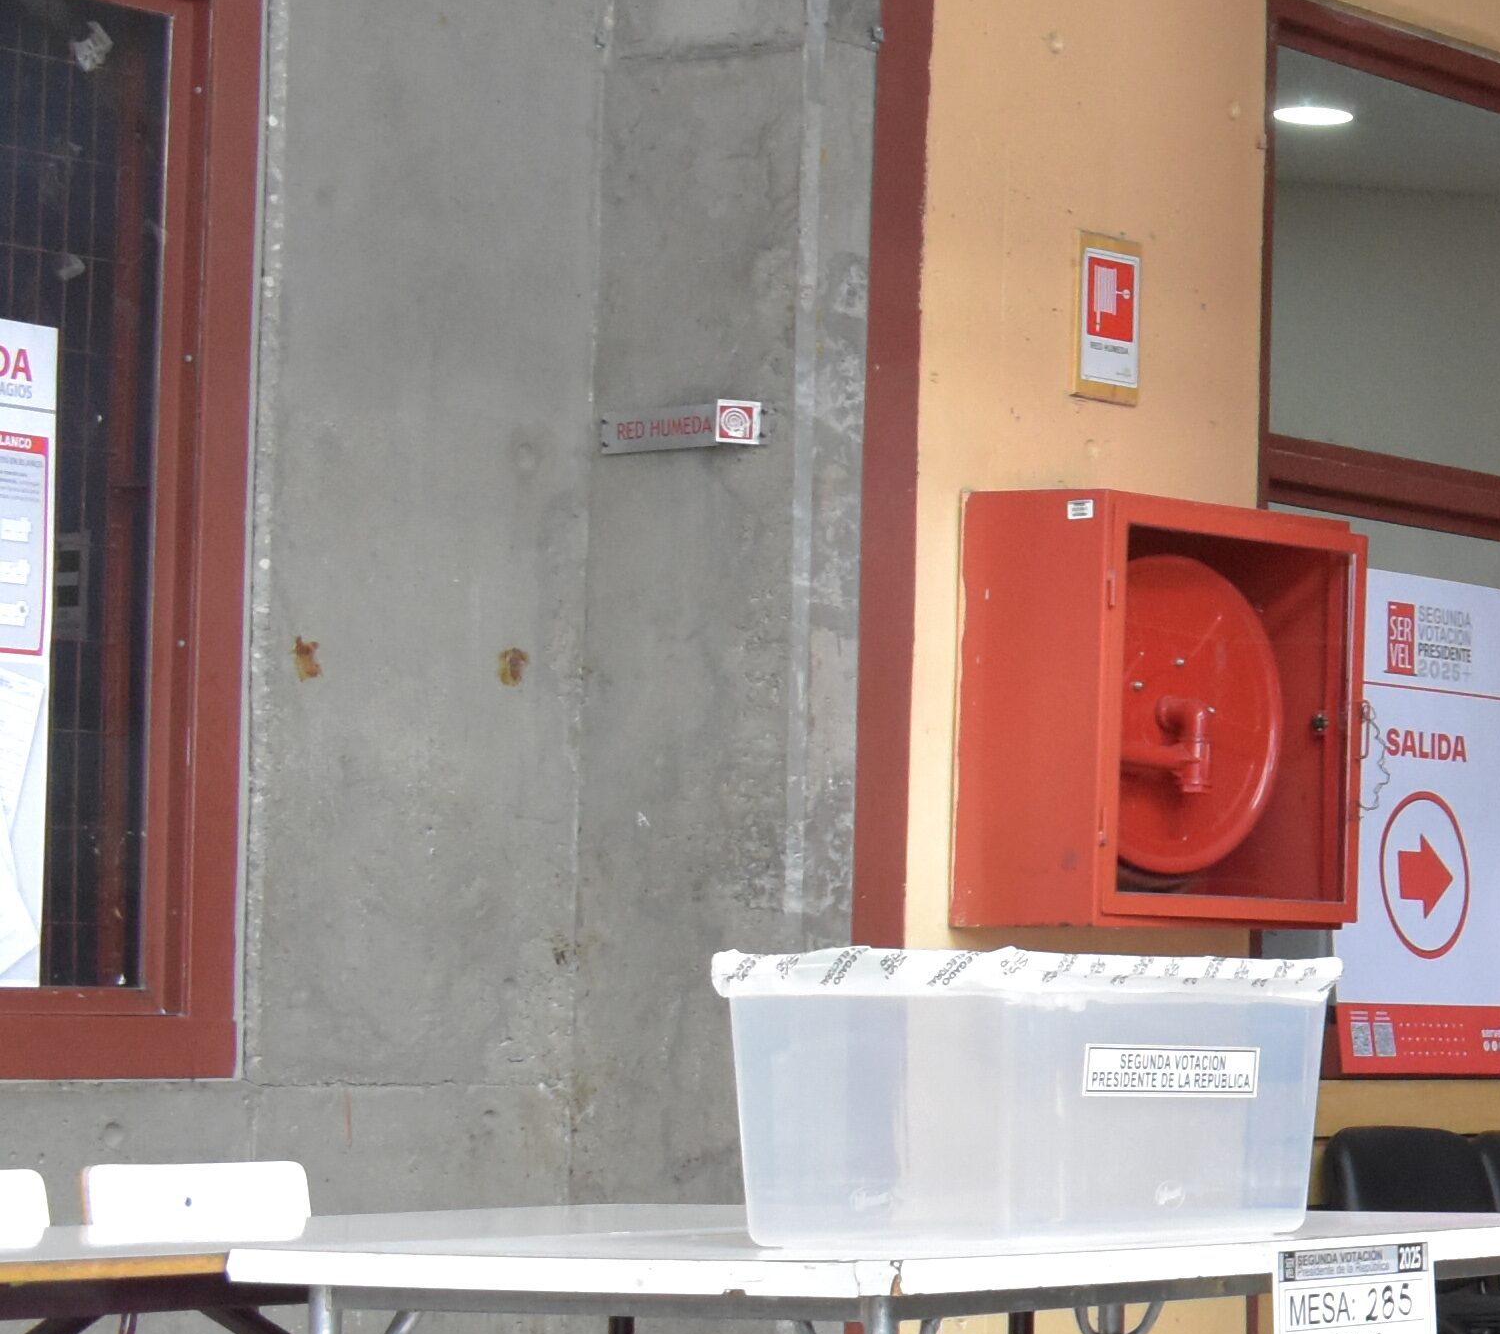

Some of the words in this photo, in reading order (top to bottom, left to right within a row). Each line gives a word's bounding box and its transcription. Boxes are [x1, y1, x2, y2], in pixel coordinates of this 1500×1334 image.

[617, 422, 645, 440] RED
[651, 416, 712, 437] HUMEDA
[1418, 606, 1472, 627] SEGUNDA
[1389, 616, 1412, 642] SER
[1389, 643, 1412, 669] VEL
[1418, 642, 1472, 663] PRESIDENTE
[1386, 728, 1467, 763] SALIDA
[1120, 1054, 1171, 1070] SEGUNDA
[1175, 1055, 1227, 1071] VOTACION
[1092, 1072, 1157, 1088] PRESIDENTE
[1161, 1072, 1174, 1088] DE
[1178, 1073, 1191, 1088] LA
[1194, 1073, 1250, 1089] REPUBLICA
[1297, 1251, 1337, 1267] SEGUNDA
[1400, 1245, 1421, 1270] 2025
[1289, 1291, 1356, 1327] MESA:
[1365, 1282, 1413, 1323] 285
